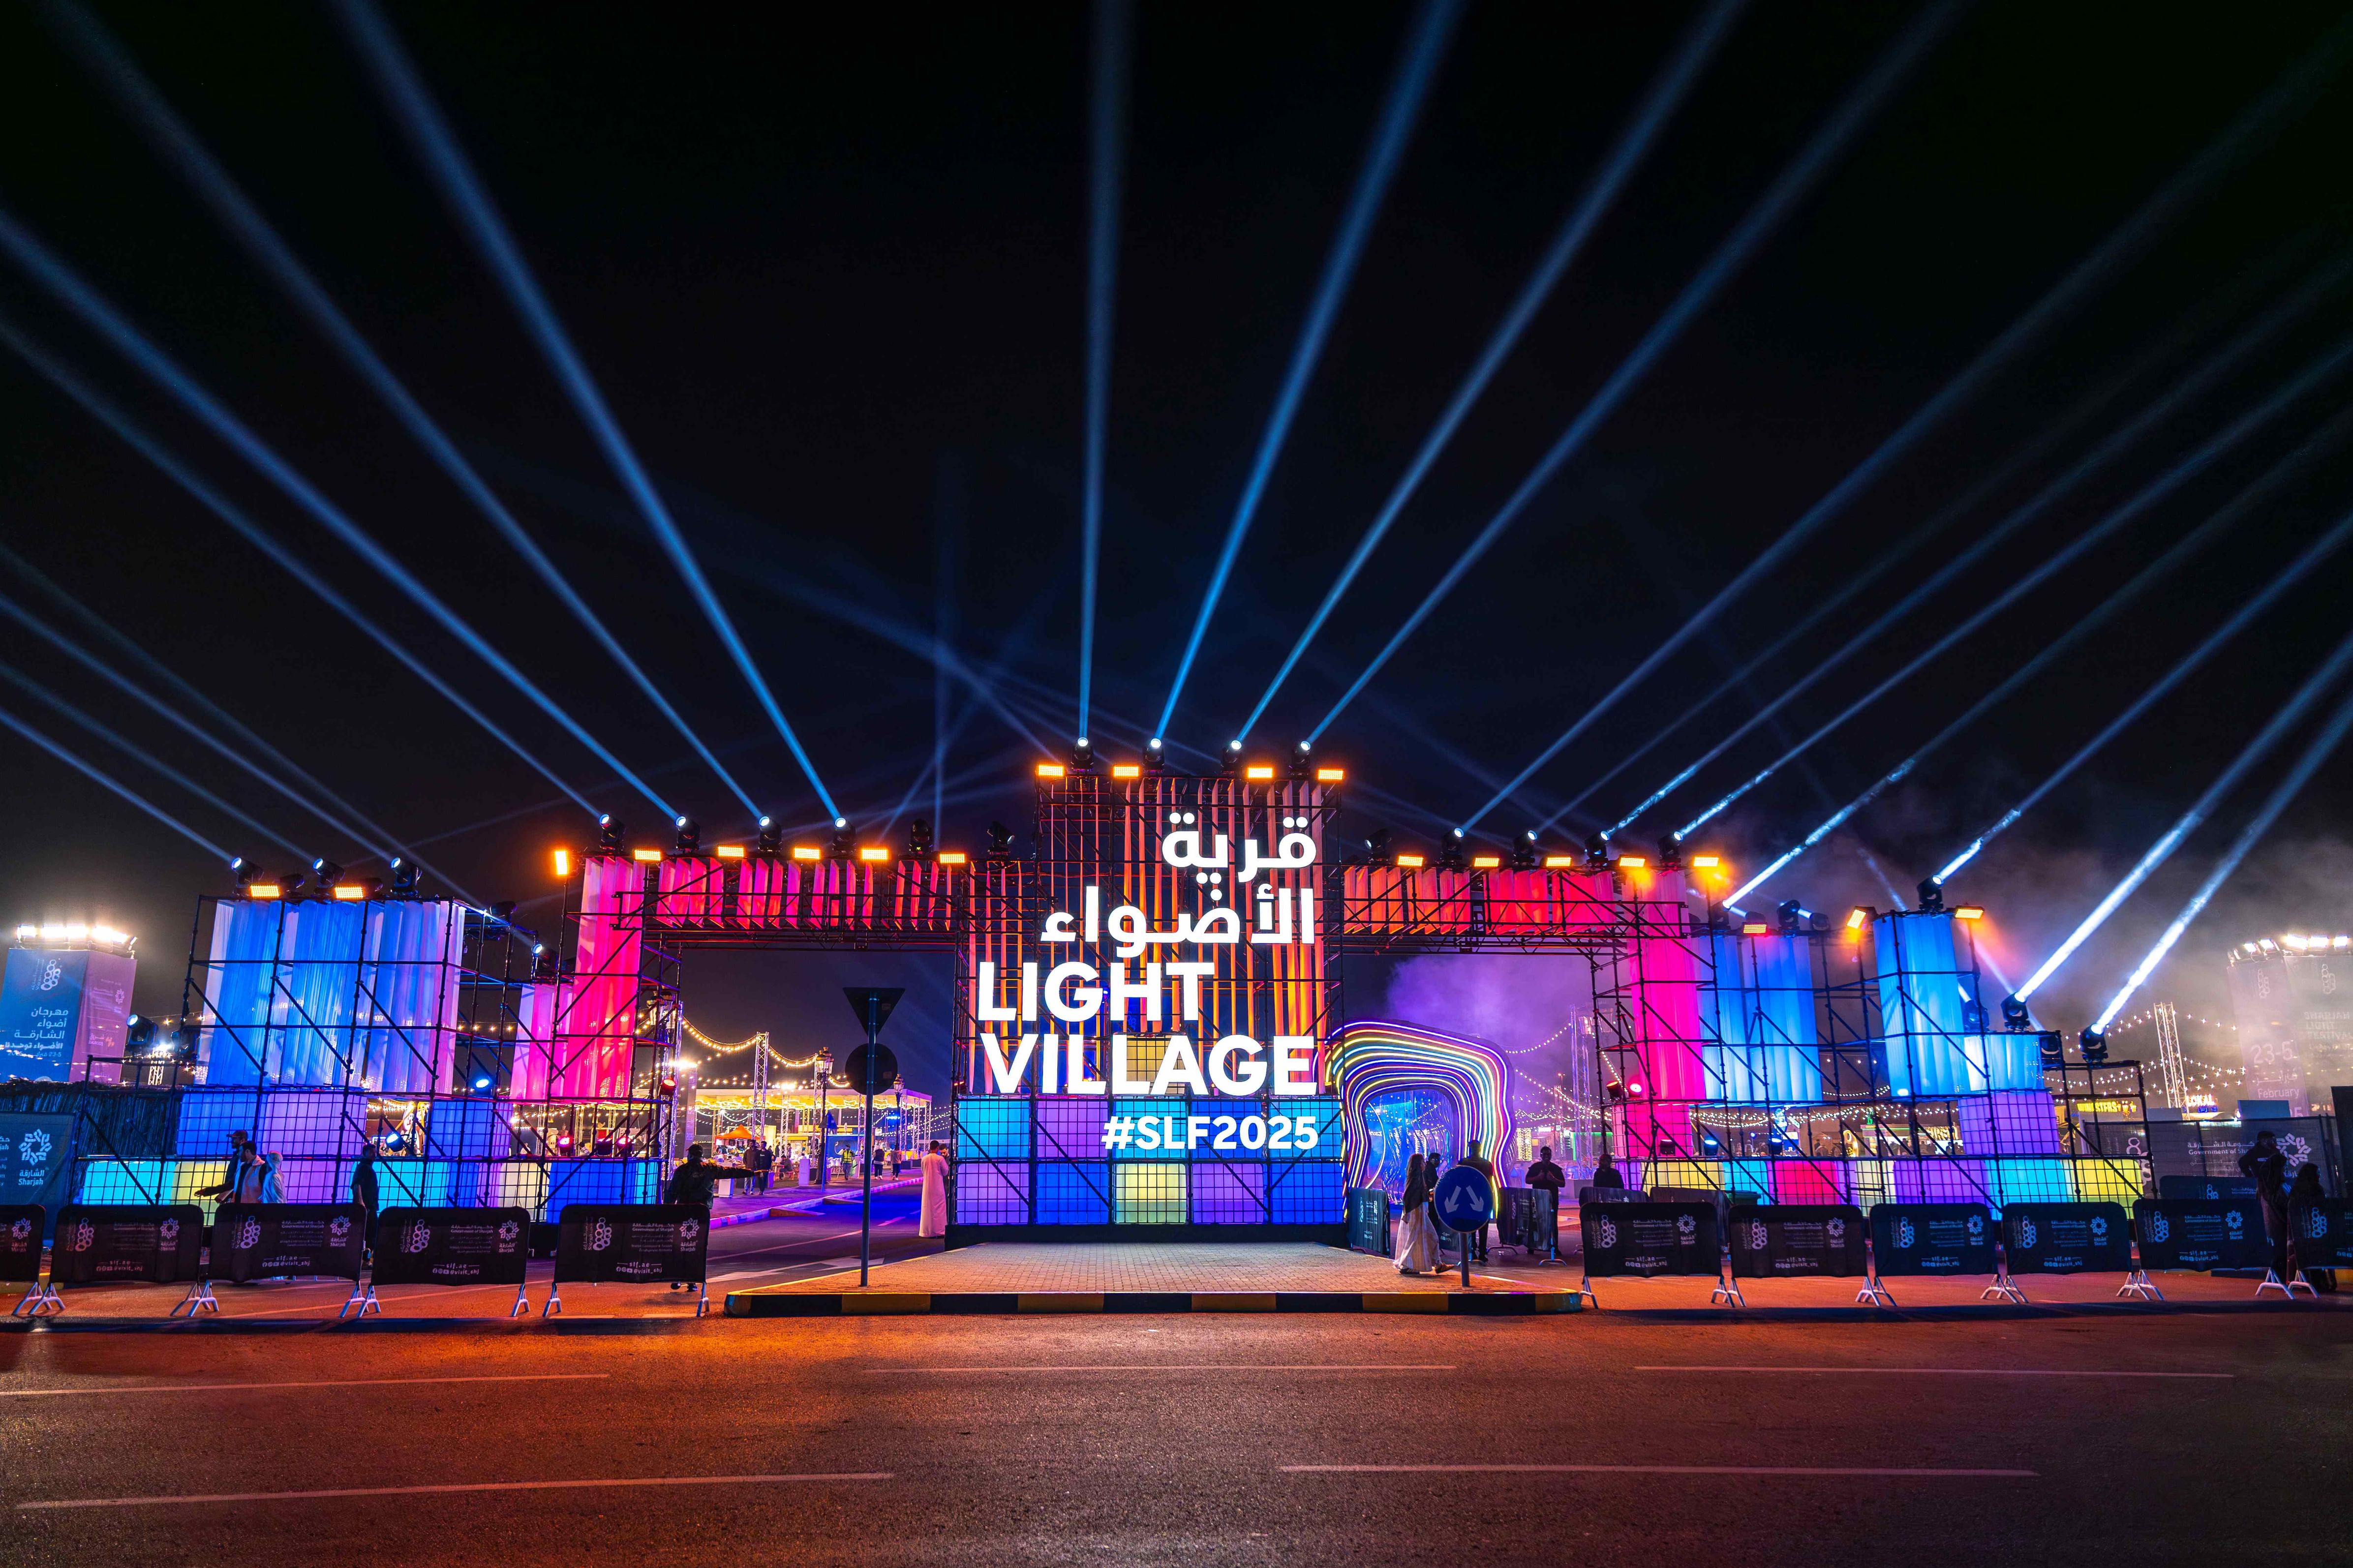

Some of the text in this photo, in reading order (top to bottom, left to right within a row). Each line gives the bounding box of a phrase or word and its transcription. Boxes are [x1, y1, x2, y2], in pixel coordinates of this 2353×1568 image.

[1162, 812, 1316, 884] قرية
[1040, 883, 1315, 958] الأضواء
[978, 962, 1215, 1022] LIGHT
[31, 1007, 69, 1017] مهرجان
[37, 1016, 67, 1029] أضواء
[14, 1029, 65, 1040] الشارقة
[2251, 1041, 2293, 1063] 23-5
[980, 1033, 1317, 1096] VILLAGE
[2258, 1088, 2299, 1099] February
[1101, 1116, 1318, 1149] #SLF2025
[20, 1169, 44, 1178] الشارقة
